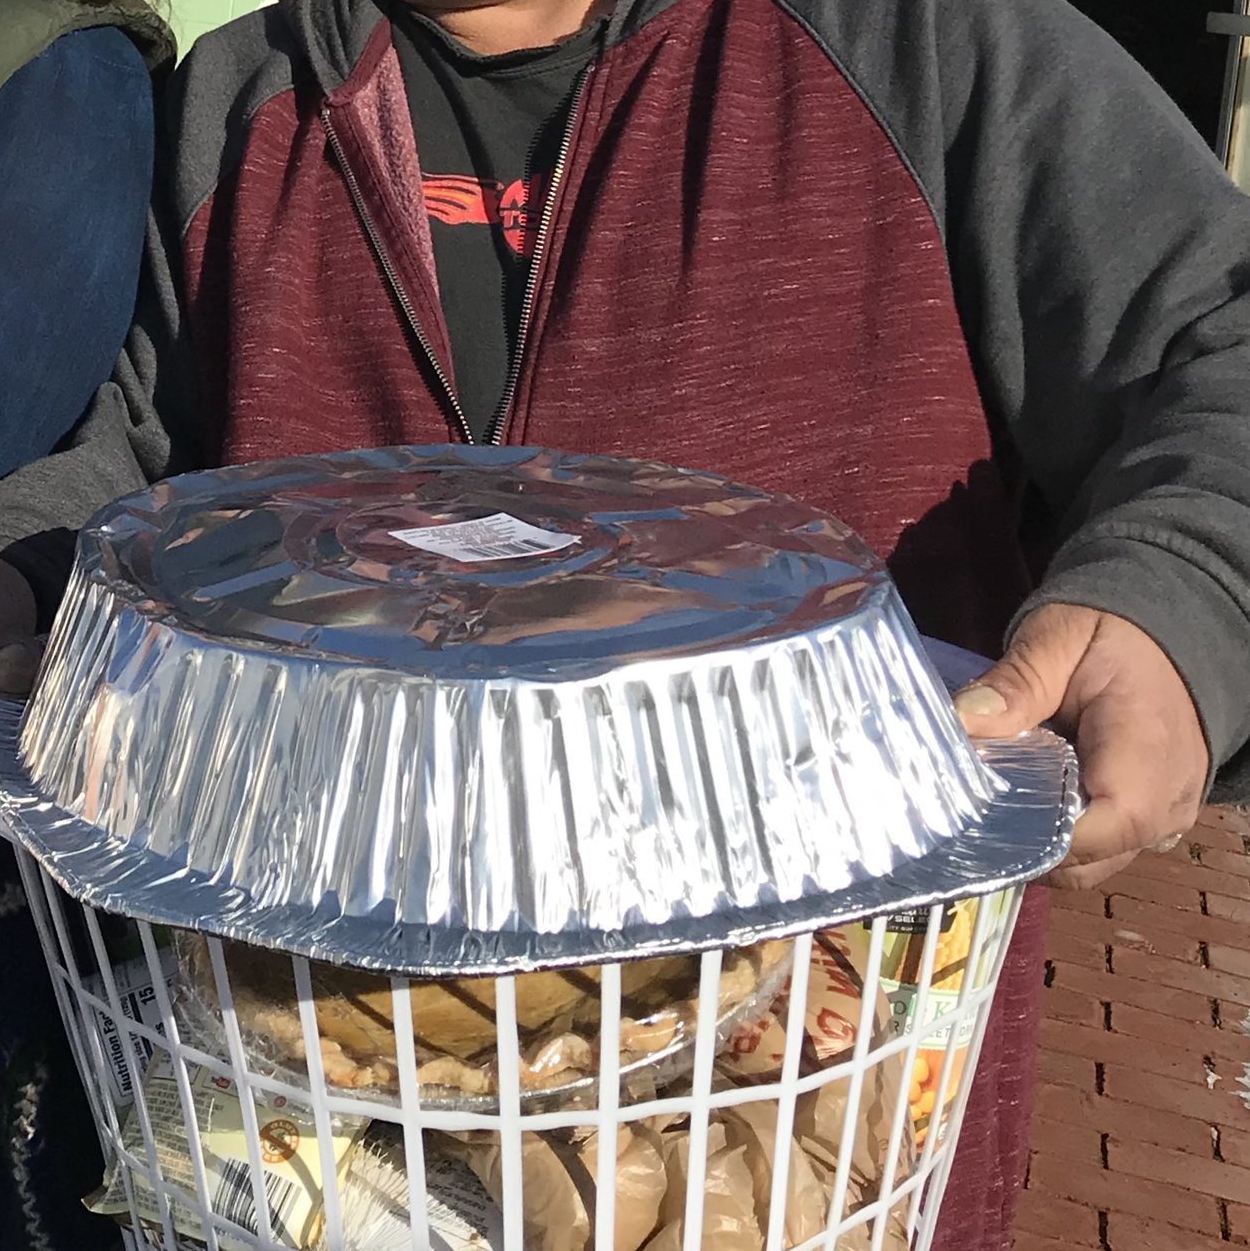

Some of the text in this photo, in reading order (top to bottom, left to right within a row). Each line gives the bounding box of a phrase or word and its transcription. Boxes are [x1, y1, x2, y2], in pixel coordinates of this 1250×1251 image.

[138, 986, 157, 1006] 15
[98, 1010, 132, 1092] Nutrition Fac
